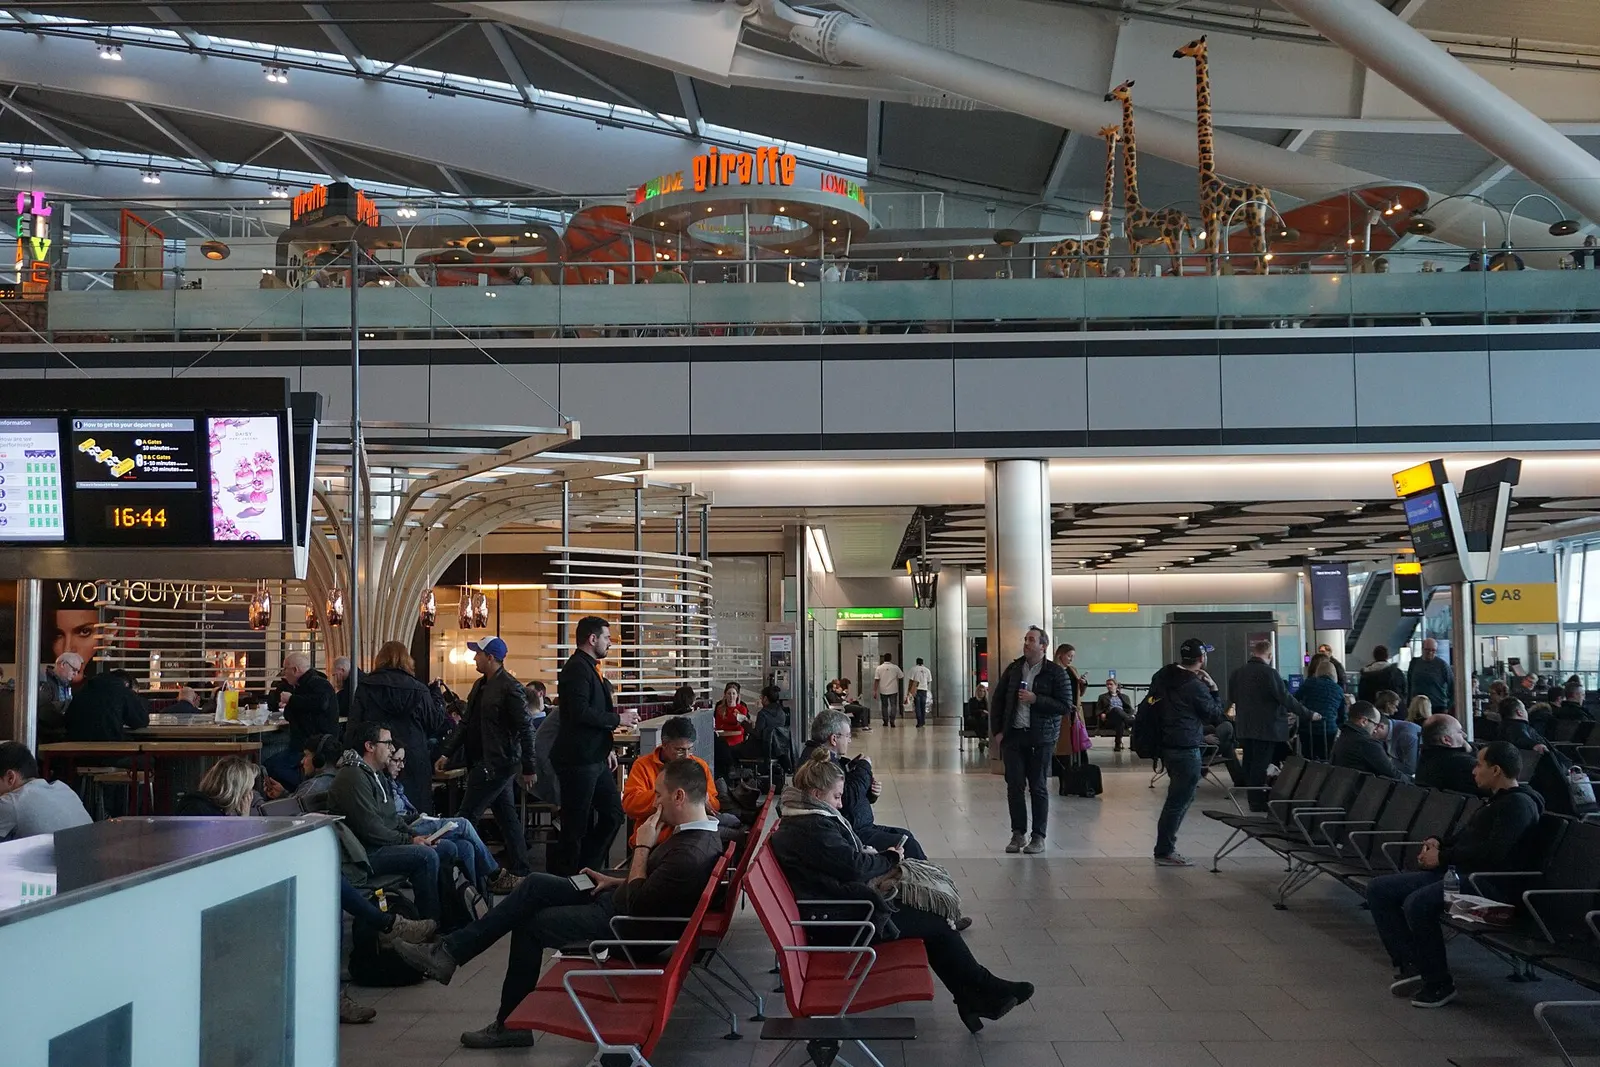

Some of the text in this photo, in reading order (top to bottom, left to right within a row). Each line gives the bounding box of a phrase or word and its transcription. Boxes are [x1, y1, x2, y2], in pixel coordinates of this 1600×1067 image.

[692, 145, 797, 193] giraffe
[821, 172, 848, 197] LOVE
[293, 183, 328, 221] giraffe
[114, 507, 167, 528] 16:44
[1501, 588, 1522, 601] A8
